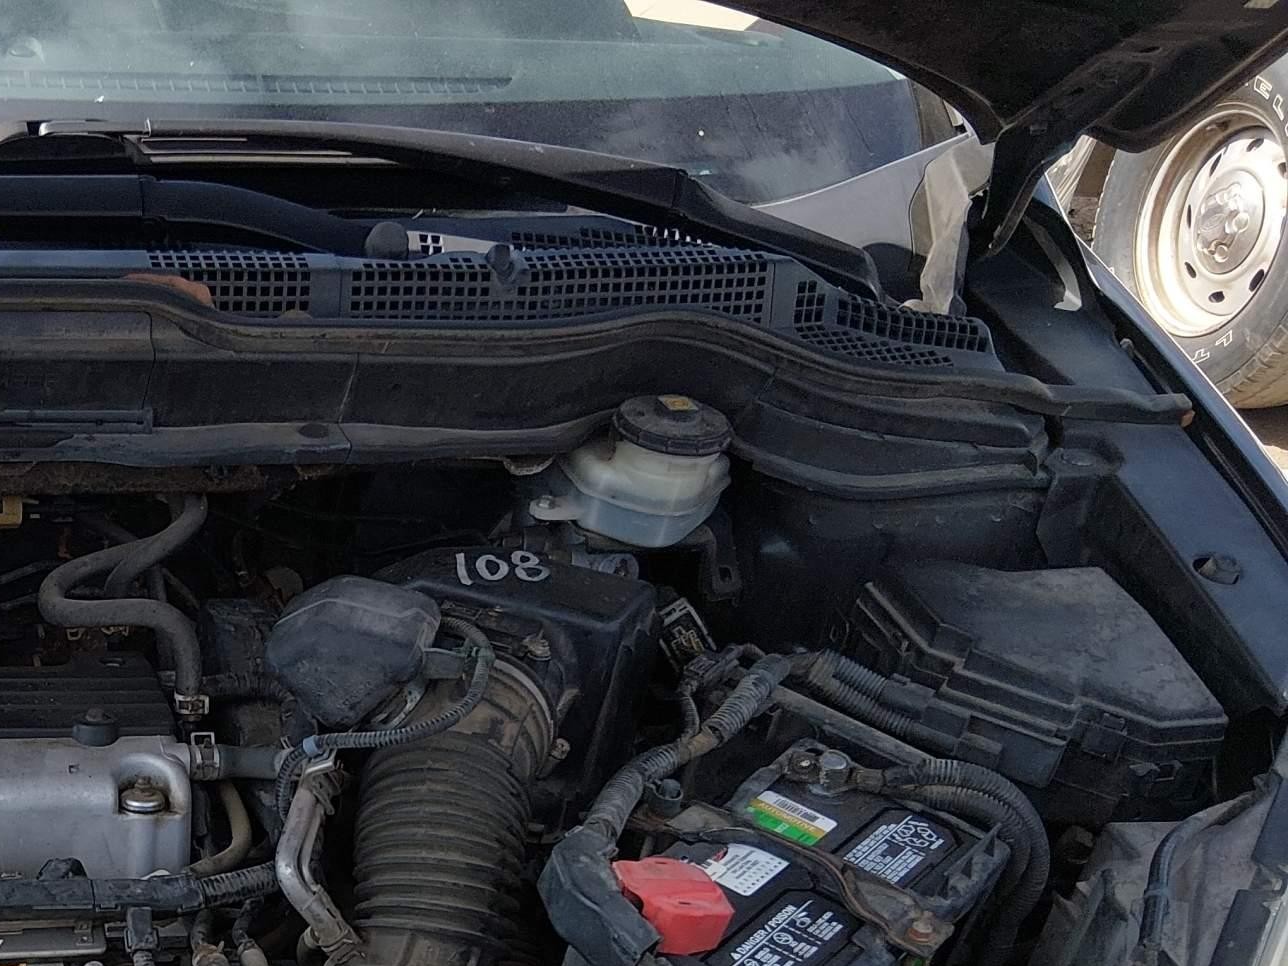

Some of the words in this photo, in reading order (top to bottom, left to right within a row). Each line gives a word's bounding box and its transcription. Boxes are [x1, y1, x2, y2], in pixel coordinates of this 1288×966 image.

[455, 550, 550, 586] 108
[758, 802, 816, 833] AUTOMOTIVE
[735, 927, 768, 956] DANGER
[768, 904, 798, 929] POISON
